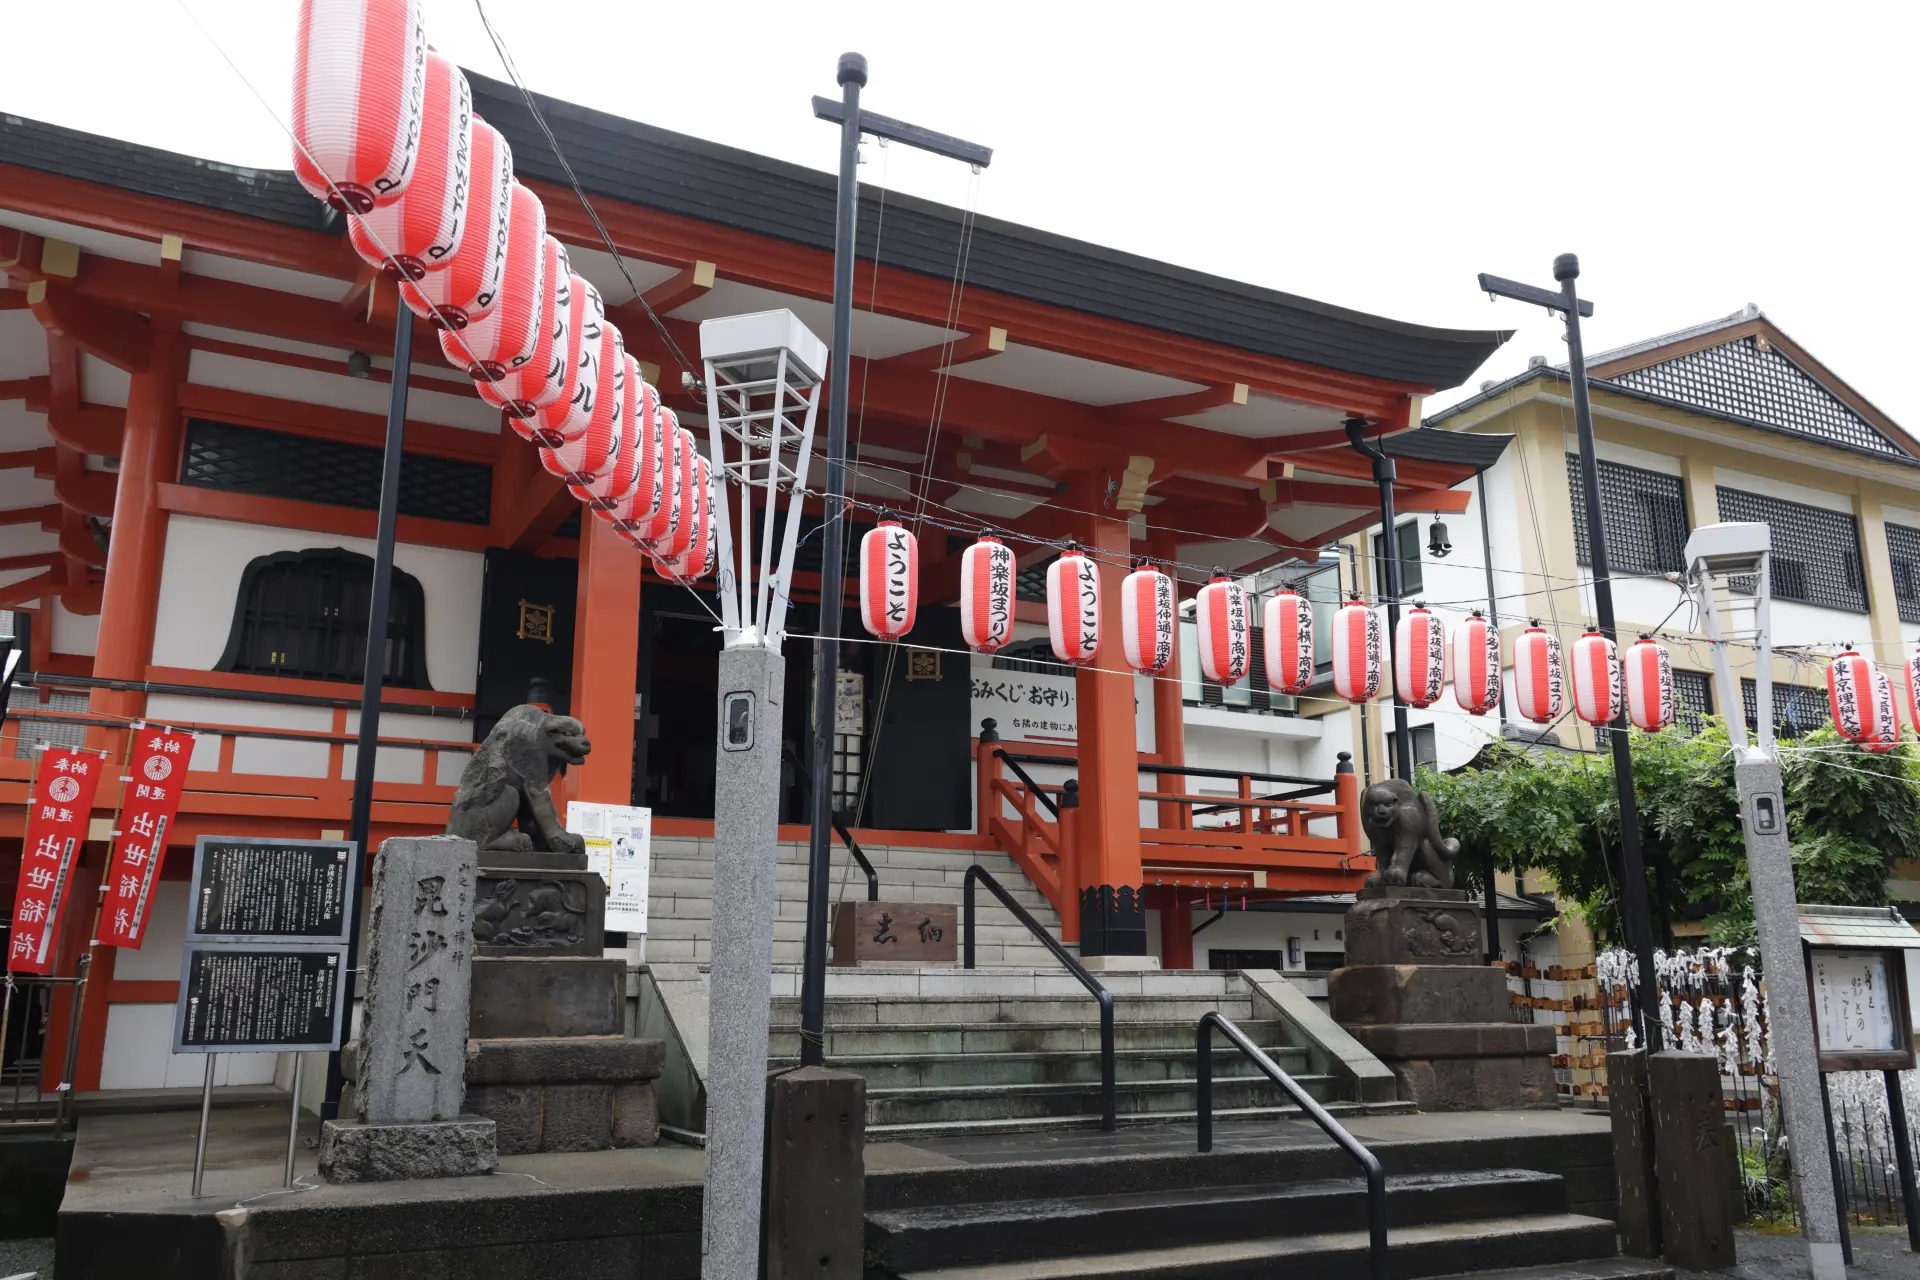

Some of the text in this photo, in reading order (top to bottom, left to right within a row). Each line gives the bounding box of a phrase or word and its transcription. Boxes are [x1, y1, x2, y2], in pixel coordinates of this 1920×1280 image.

[887, 532, 906, 622] ようこそ
[985, 546, 1010, 645] 神楽坂まつりへ
[1079, 561, 1098, 651] ようこそ
[1226, 584, 1246, 677] 神楽坂通り商店会
[1424, 616, 1442, 700] 神楽坂通り商店会
[1483, 626, 1499, 708] 本多横丁商店会
[1544, 636, 1562, 718] 神楽坂まつりへ
[1607, 645, 1620, 715] ようこそ
[1656, 648, 1672, 726] 神楽坂まつりへ
[1834, 660, 1861, 737] 東京理科大学
[396, 875, 448, 1076] 毘沙門天
